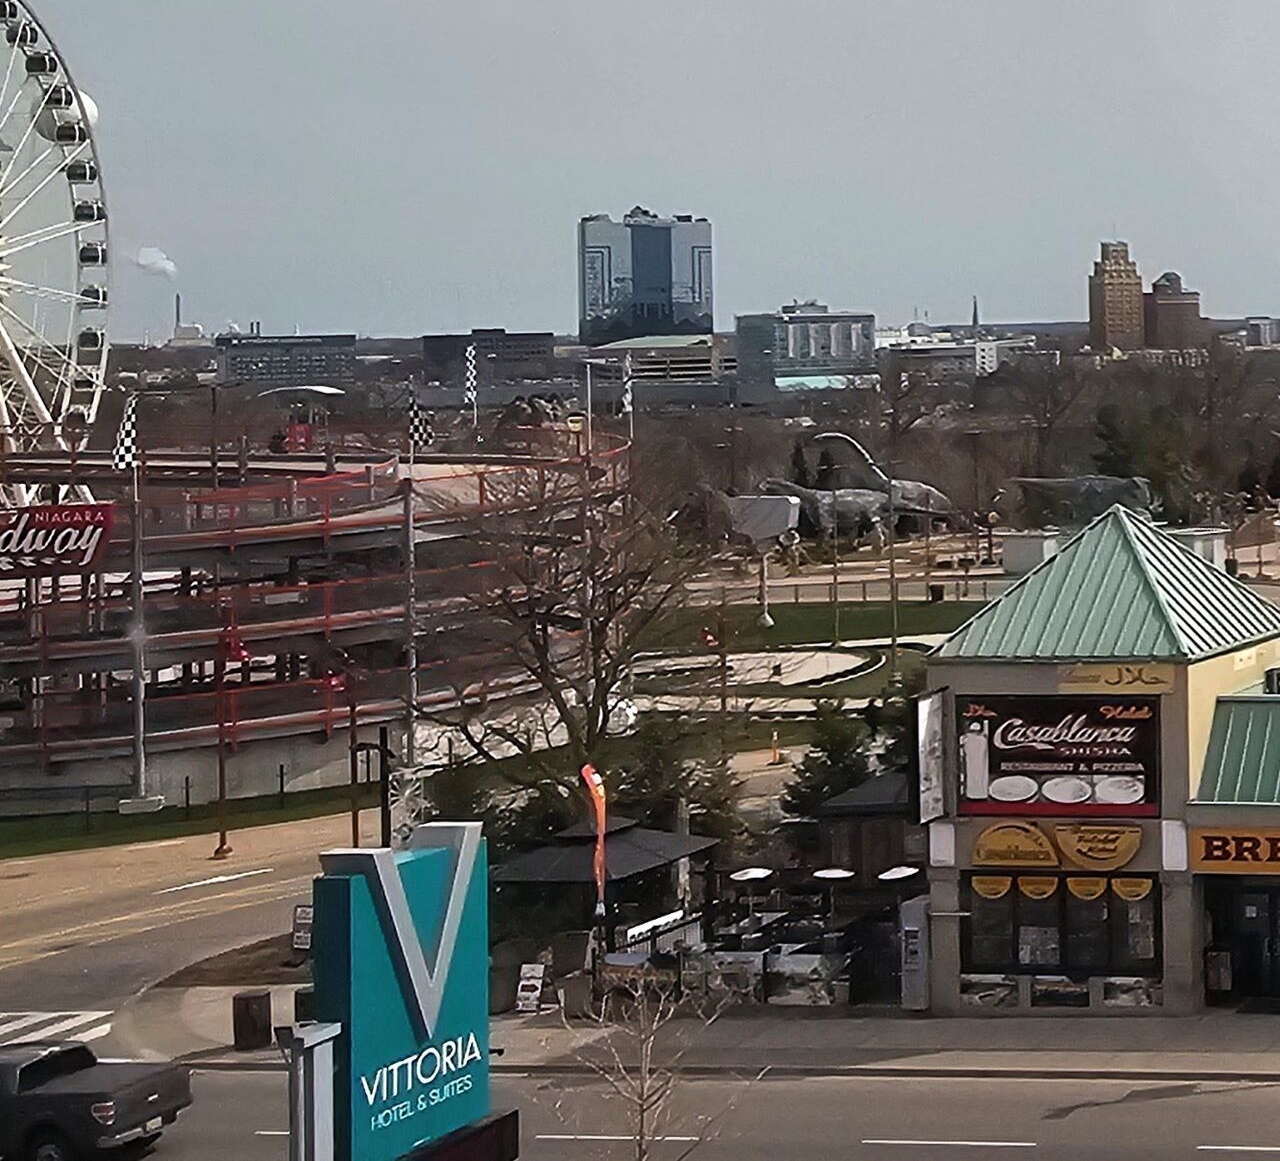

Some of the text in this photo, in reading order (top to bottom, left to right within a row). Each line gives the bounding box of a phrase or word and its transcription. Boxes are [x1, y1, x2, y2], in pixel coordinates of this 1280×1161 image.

[35, 510, 104, 523] NIAGARA
[993, 714, 1137, 750] Casablanca
[361, 1032, 482, 1106] VITTORIA
[370, 1073, 473, 1131] HOTEL & SUITES
